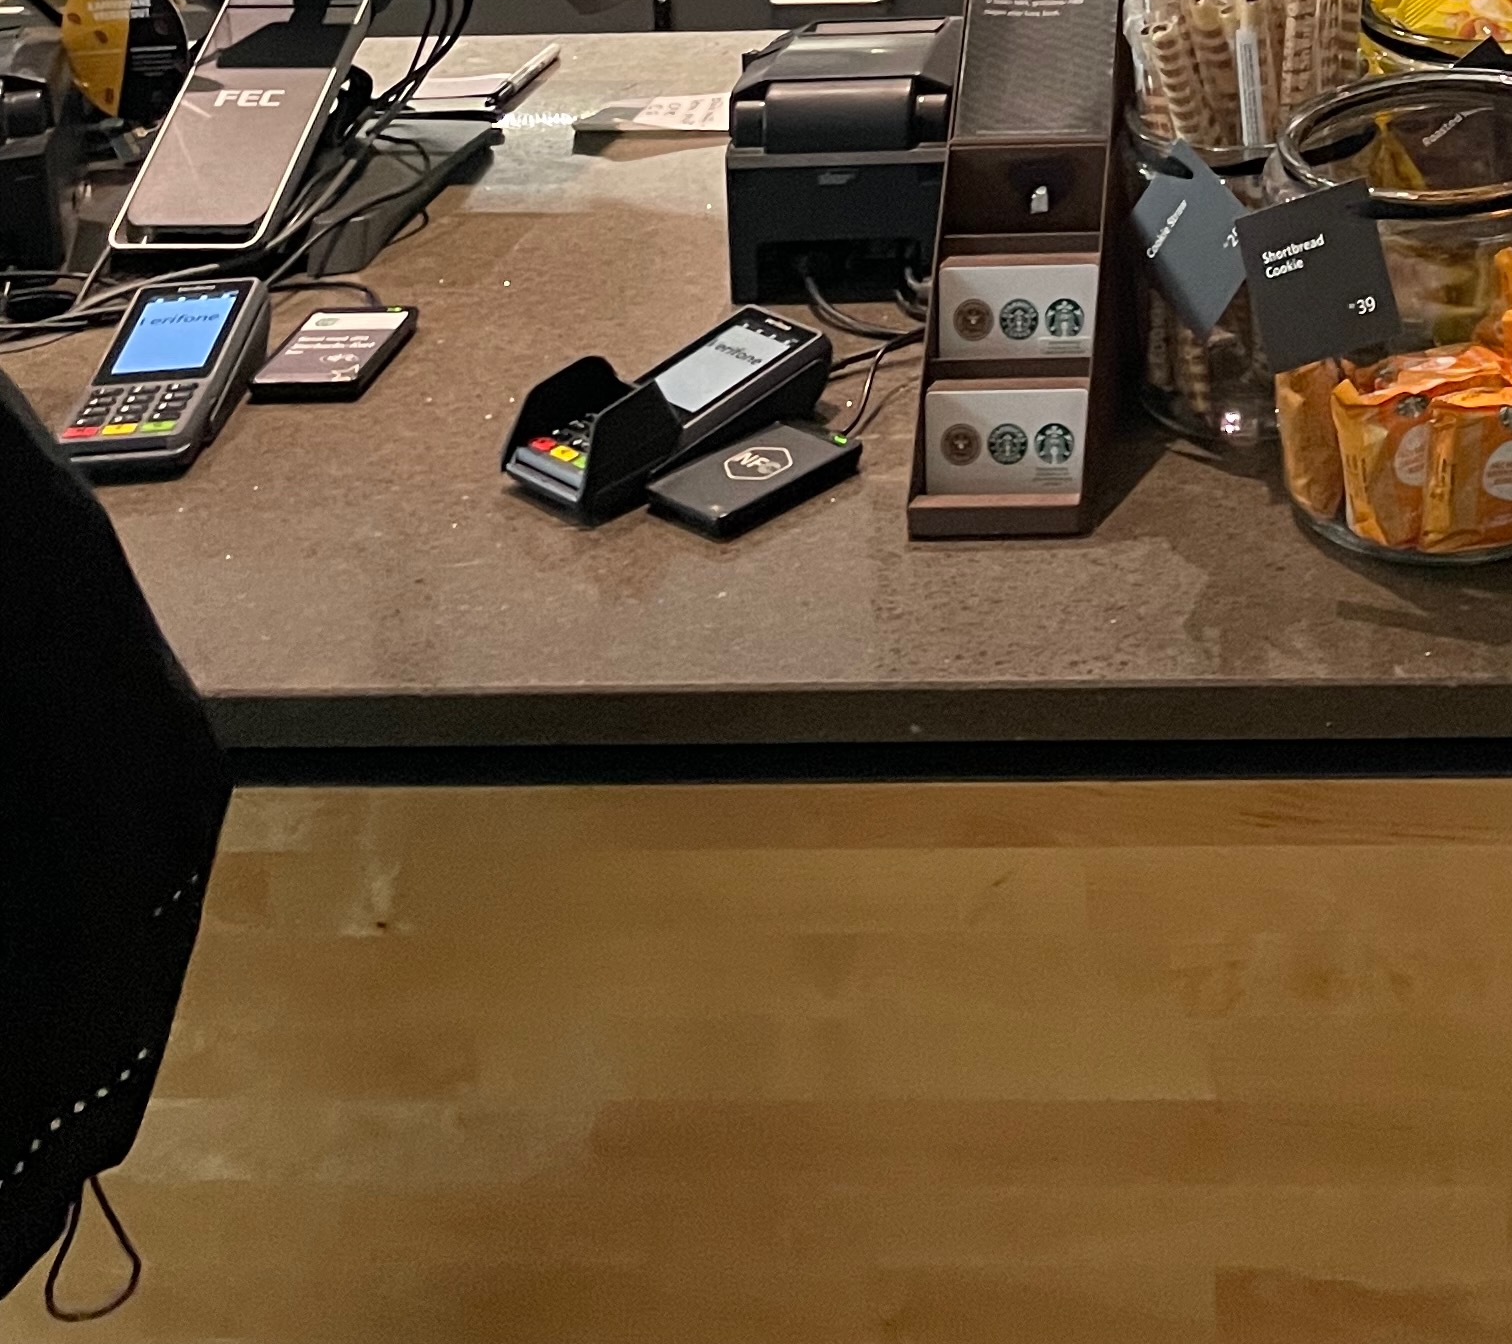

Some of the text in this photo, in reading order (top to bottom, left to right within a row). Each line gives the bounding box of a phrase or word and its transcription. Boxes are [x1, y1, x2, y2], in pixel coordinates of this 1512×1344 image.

[214, 90, 285, 107] FEC
[1262, 234, 1324, 266] Shortbread
[1265, 256, 1304, 279] Cookie
[140, 313, 220, 326] erifone
